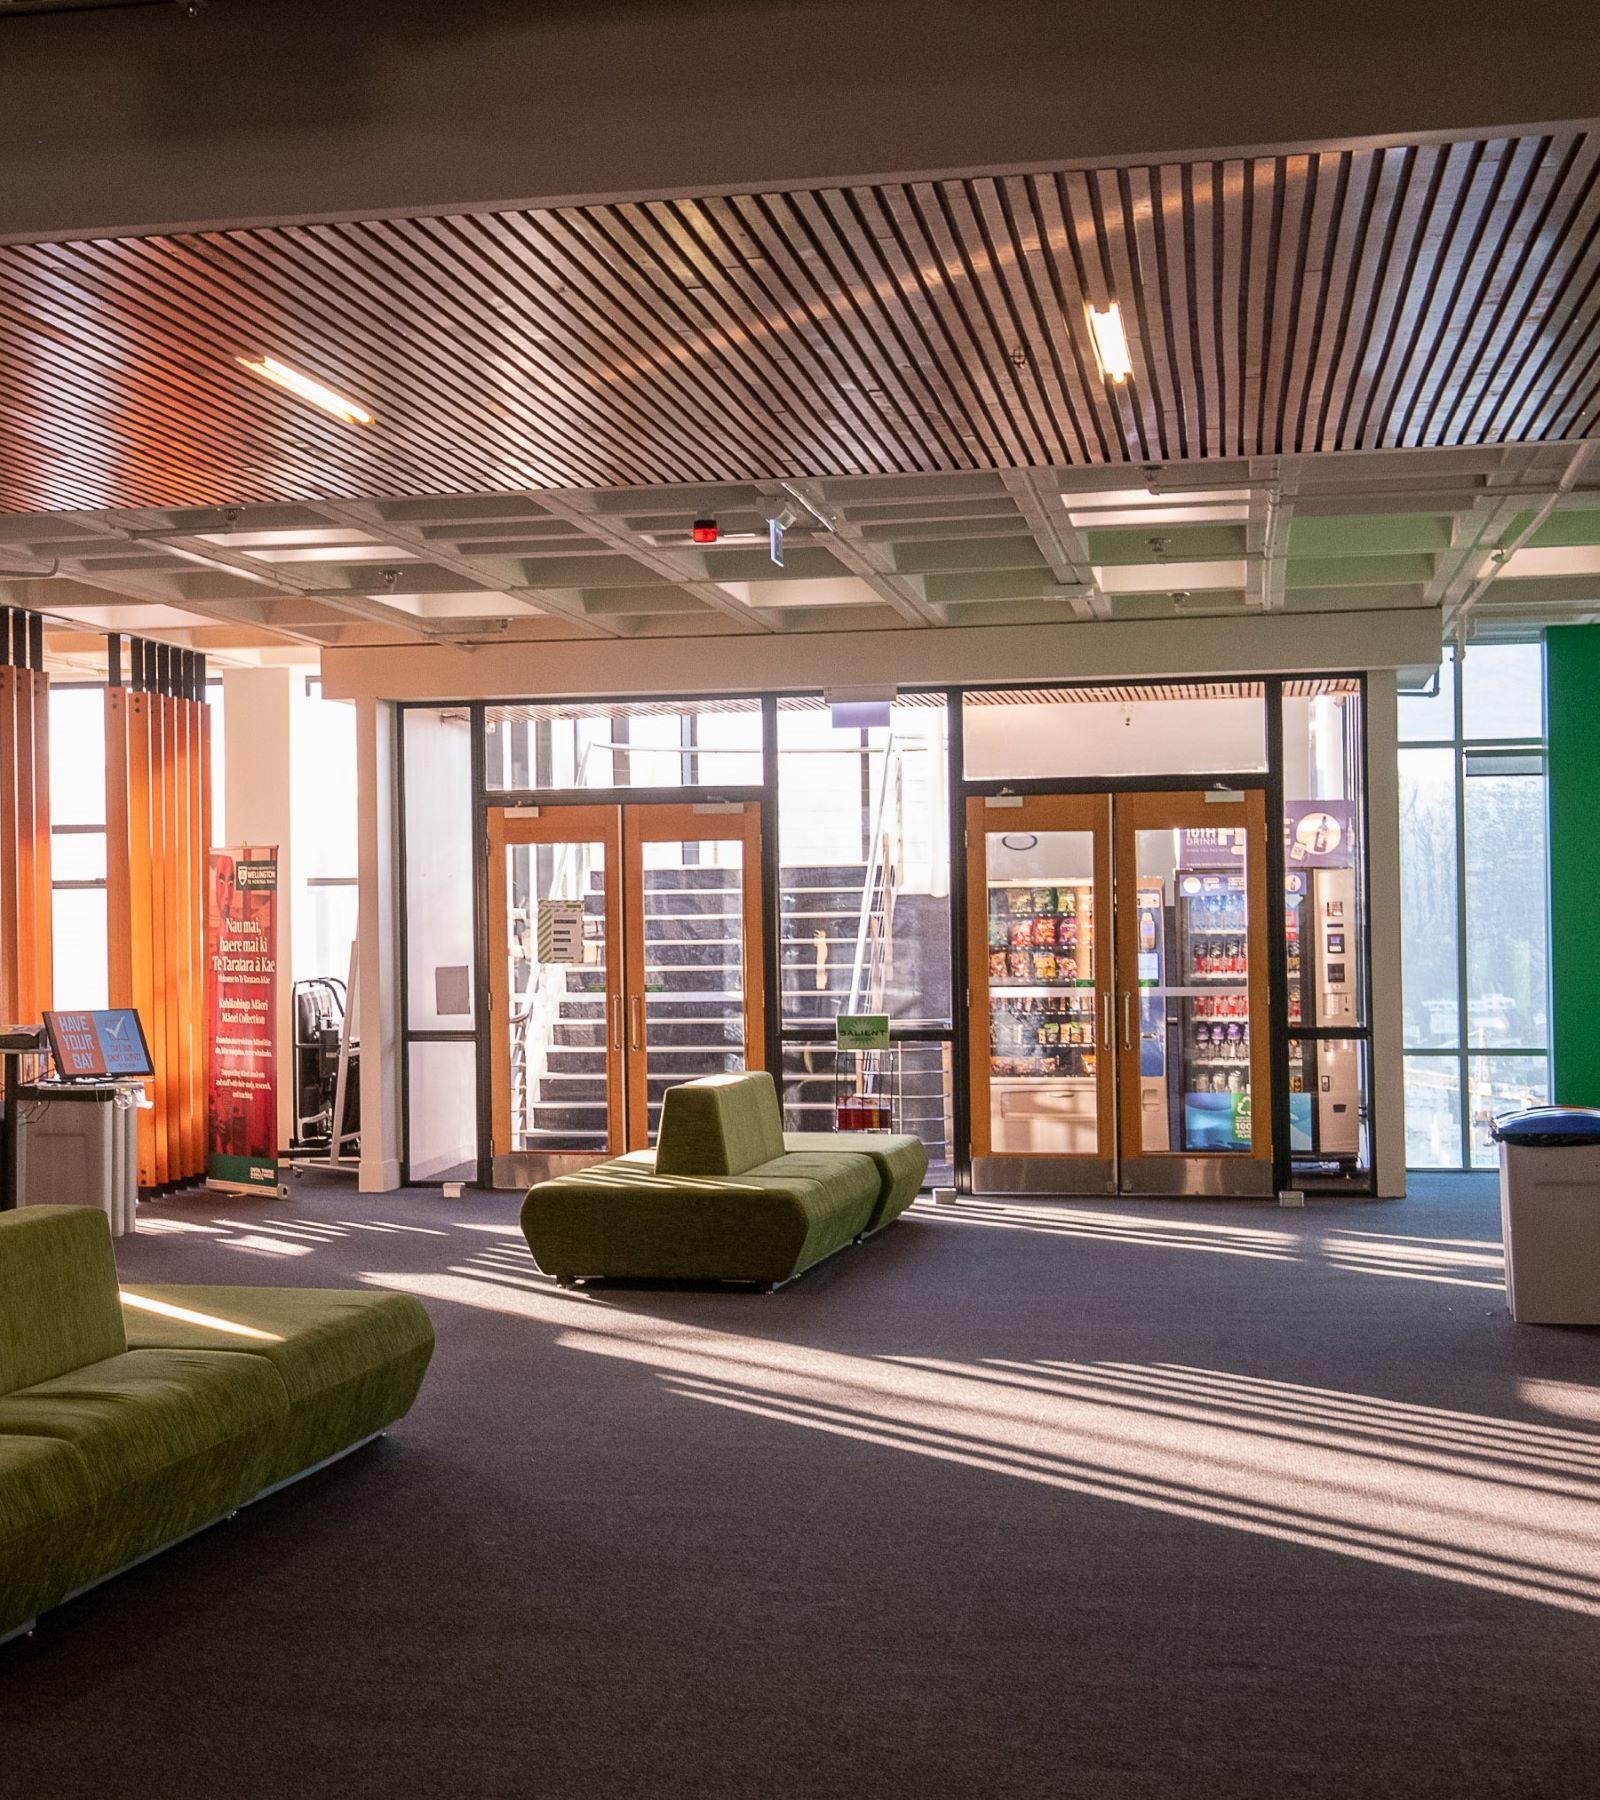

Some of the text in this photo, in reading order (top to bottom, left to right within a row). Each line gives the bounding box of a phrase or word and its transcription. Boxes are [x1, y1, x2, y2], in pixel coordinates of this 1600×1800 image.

[1186, 838, 1217, 846] DRINK
[248, 871, 276, 879] WELLINGTON
[225, 917, 262, 935] Nau mai,
[220, 936, 268, 953] haere mai ki
[212, 955, 275, 973] Te Taratara ā Kae
[58, 1015, 89, 1032] HAVE
[840, 1029, 885, 1037] SALIENT
[63, 1034, 95, 1050] YOUR
[72, 1053, 95, 1069] SAY
